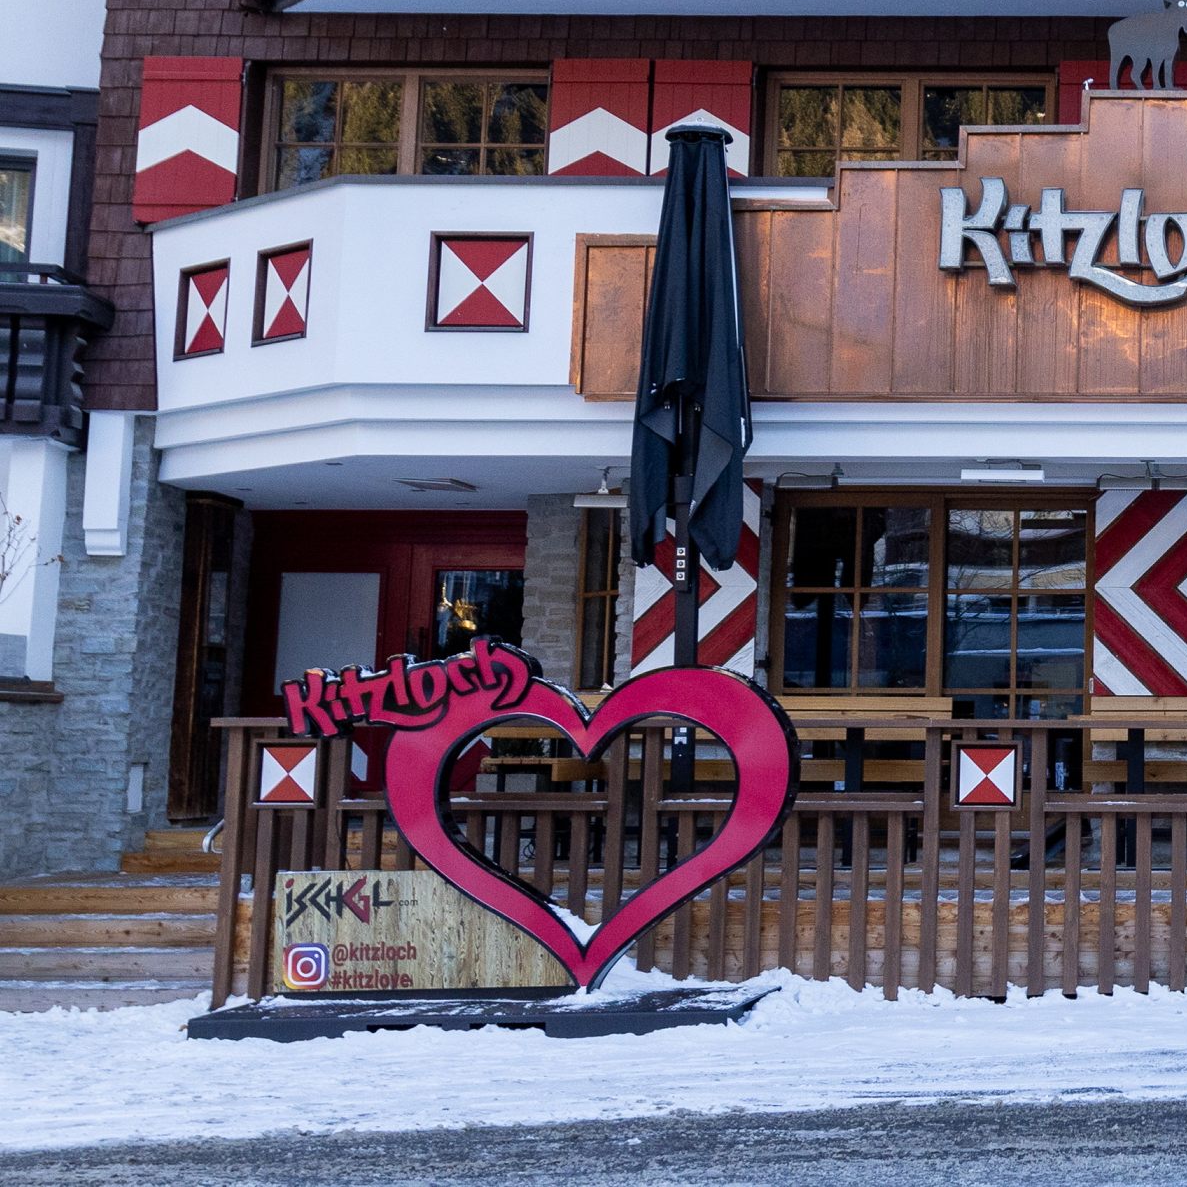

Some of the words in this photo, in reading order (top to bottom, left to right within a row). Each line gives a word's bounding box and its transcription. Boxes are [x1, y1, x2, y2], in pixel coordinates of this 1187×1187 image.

[282, 636, 537, 737] Kitzloch
[332, 941, 417, 966] @kitzloch
[332, 969, 410, 989] #kitzlove
